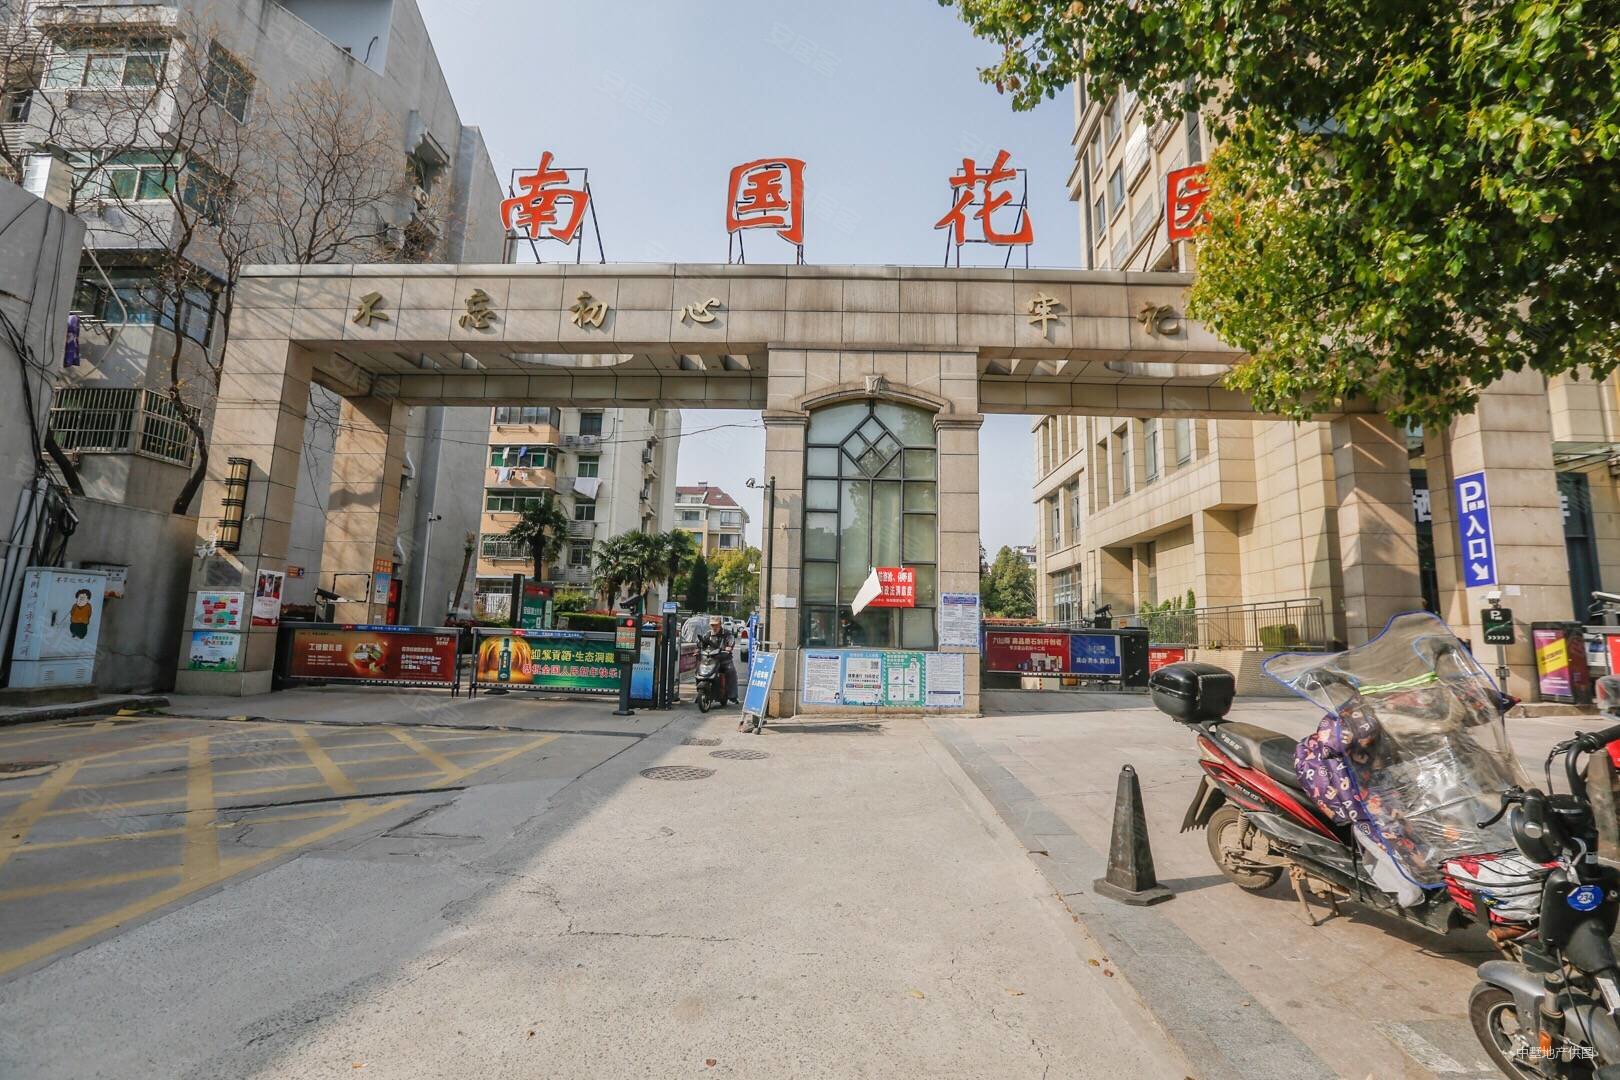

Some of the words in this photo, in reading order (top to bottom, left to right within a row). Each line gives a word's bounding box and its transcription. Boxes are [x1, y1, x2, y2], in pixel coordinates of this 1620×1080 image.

[351, 288, 722, 330] 不忘初心
[1466, 515, 1488, 561] 入口
